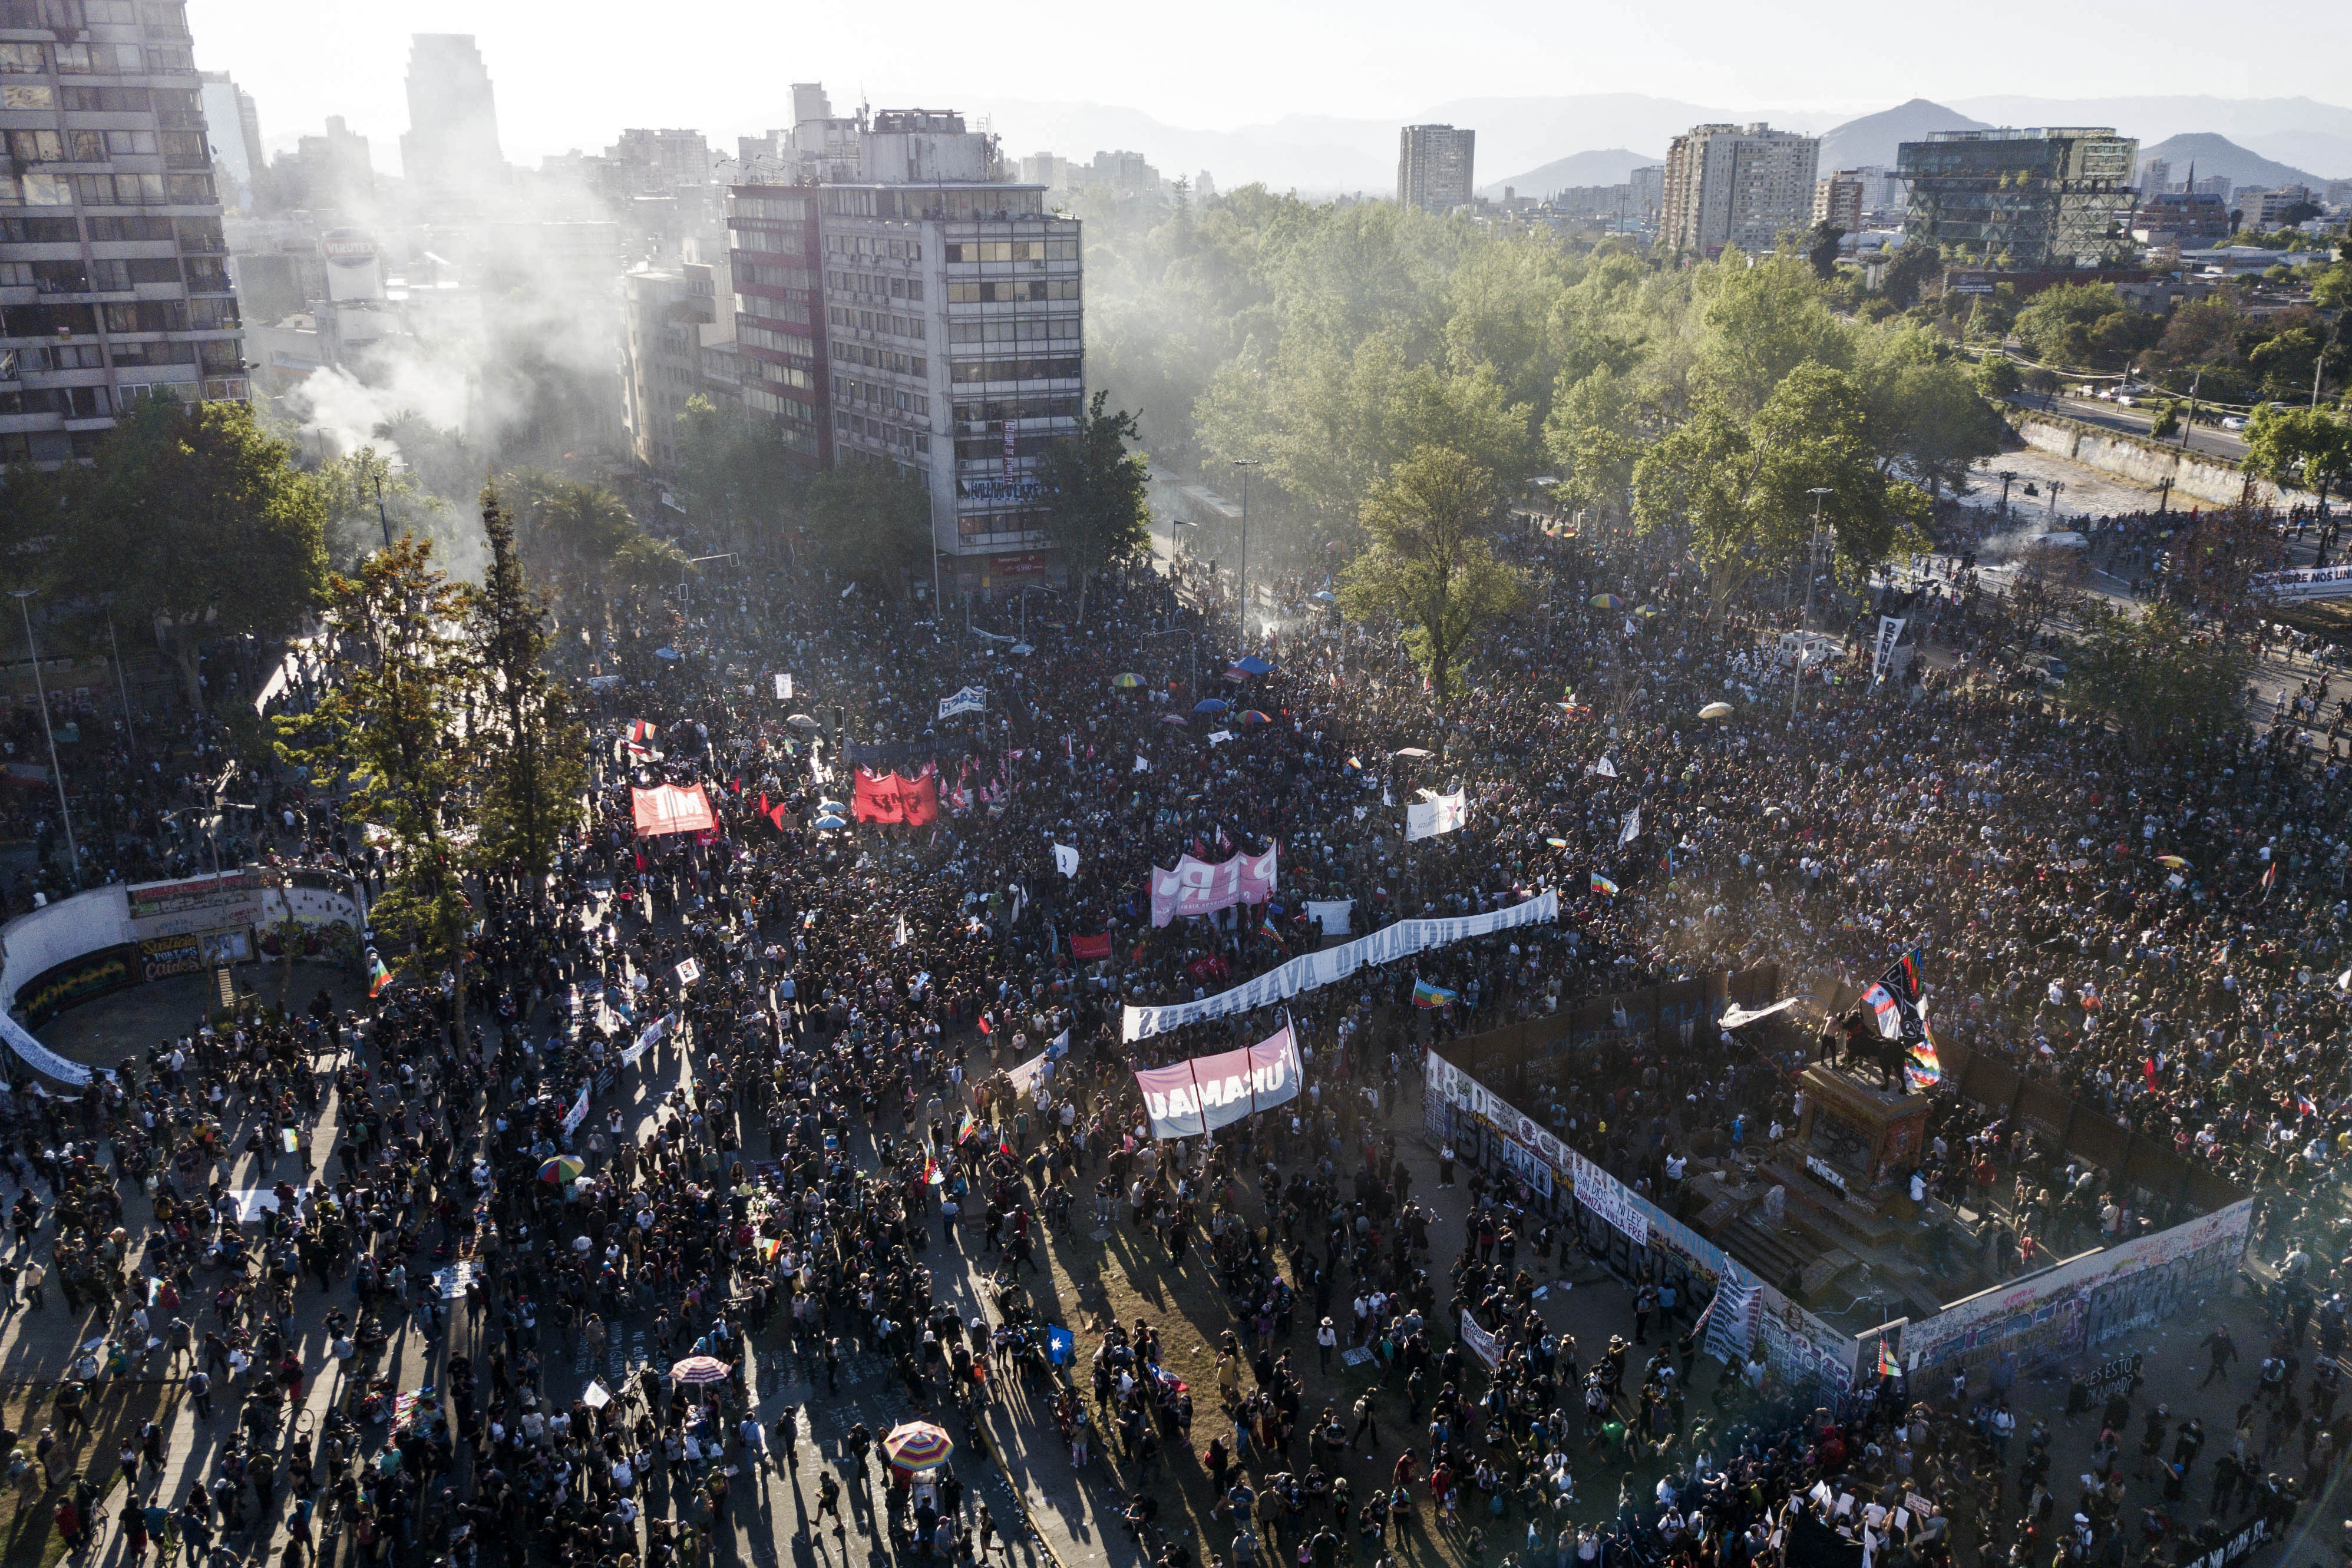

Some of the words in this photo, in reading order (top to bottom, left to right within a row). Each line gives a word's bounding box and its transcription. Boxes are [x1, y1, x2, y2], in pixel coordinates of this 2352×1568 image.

[326, 240, 378, 254] VIRUTEX
[2310, 571, 2333, 583] NOS
[1428, 1051, 1458, 1103] 18
[1471, 1081, 1501, 1125] DE
[1576, 1171, 1590, 1190] SIN
[1591, 1185, 1608, 1205] DIOS
[1617, 1201, 1626, 1216] NI
[1627, 1208, 1641, 1227] LEY
[1576, 1186, 1603, 1215] AVANZA
[1605, 1207, 1625, 1230] VILLA
[1627, 1223, 1644, 1243] FREI
[2105, 1357, 2132, 1380] ESTO
